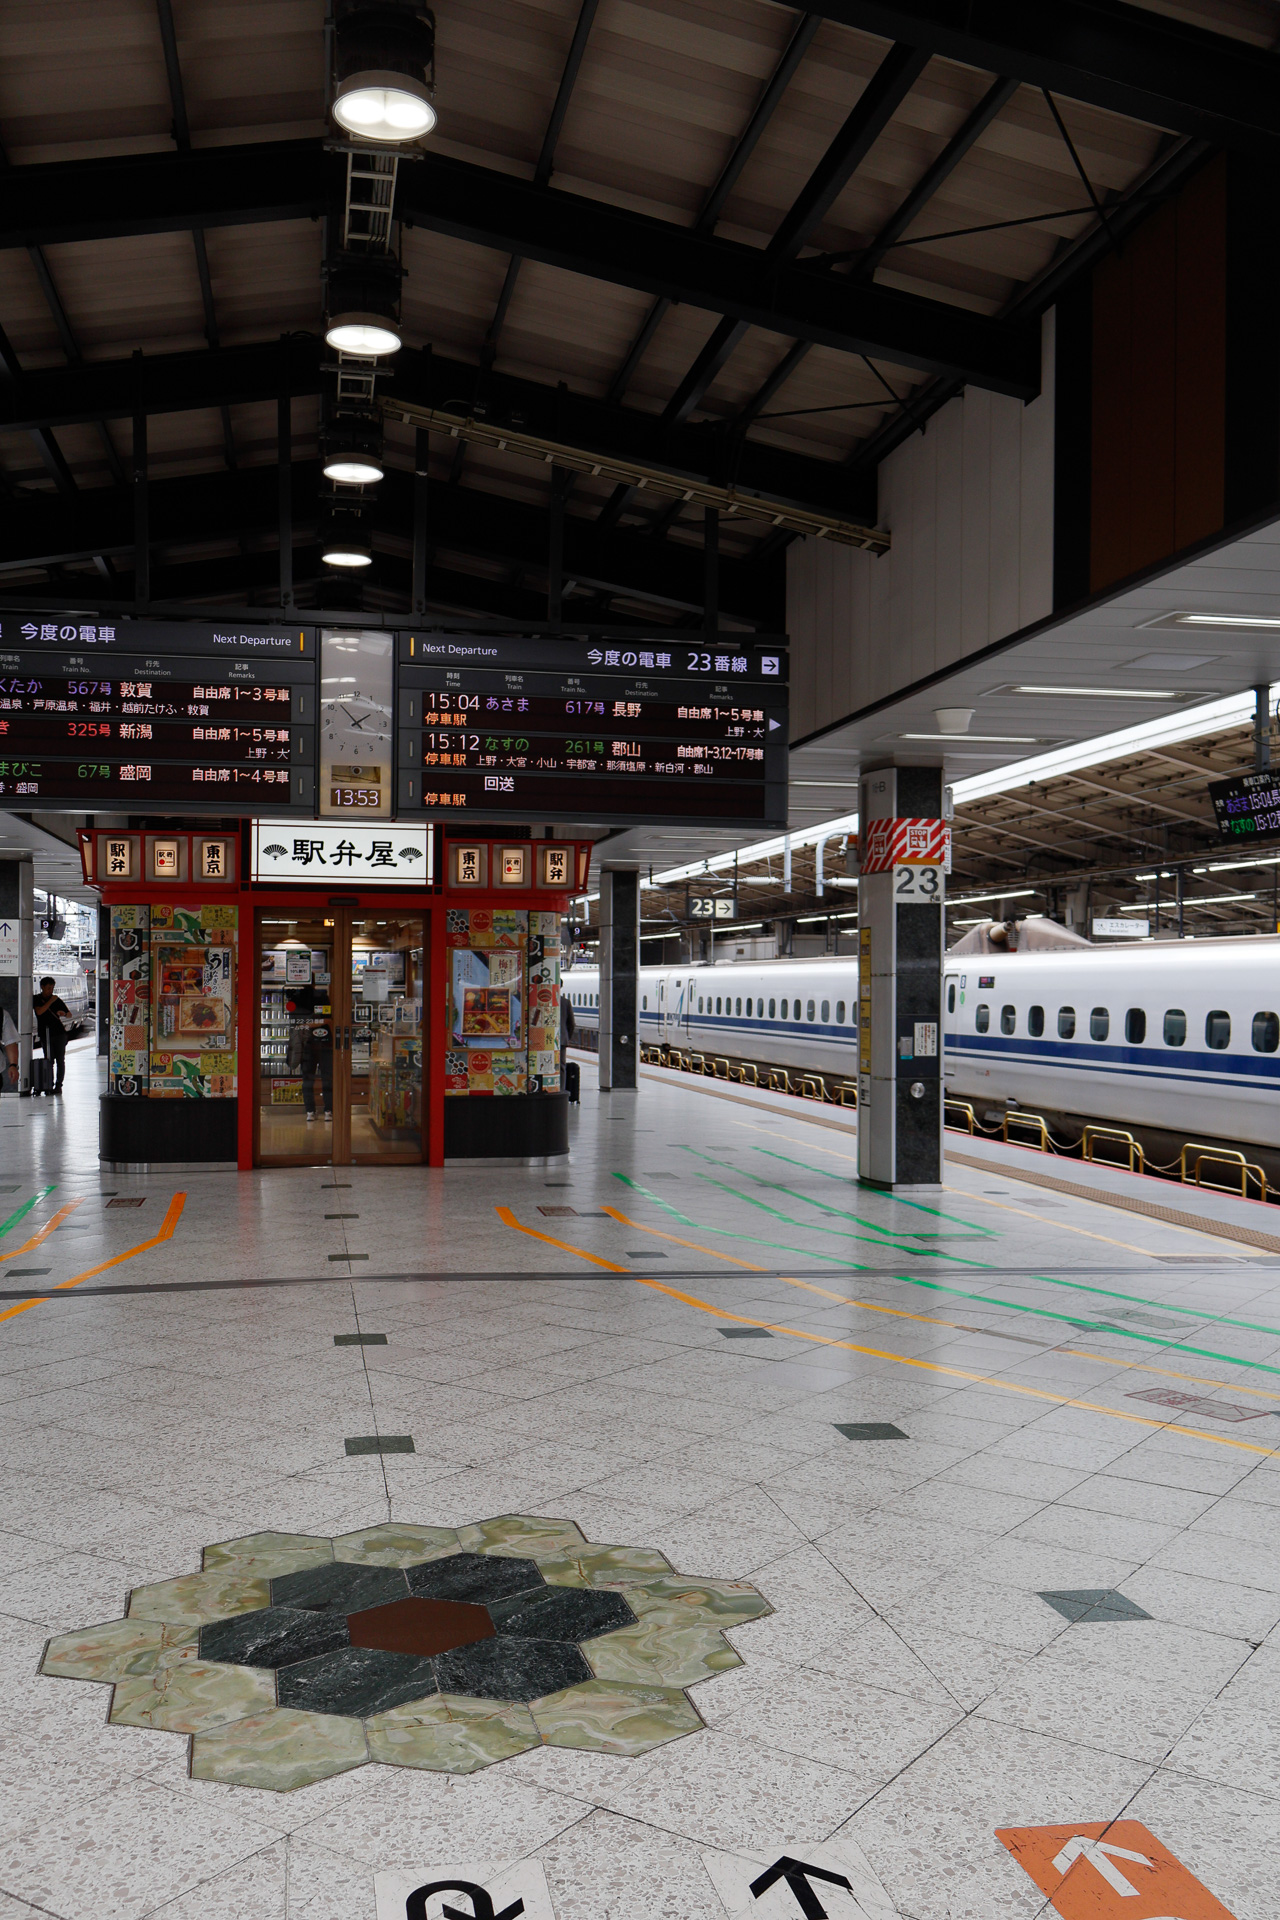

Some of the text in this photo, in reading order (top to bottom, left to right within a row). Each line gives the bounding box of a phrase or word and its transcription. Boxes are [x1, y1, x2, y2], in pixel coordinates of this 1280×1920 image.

[20, 623, 116, 644] 今度の電車
[213, 634, 292, 647] Next Departure
[422, 643, 498, 656] Next Departure
[587, 648, 748, 673] 今度の電車 23番線
[68, 682, 112, 696] 567号
[120, 682, 152, 699] 敦賀
[429, 693, 480, 710] 15:04
[486, 696, 529, 711] あさま
[565, 700, 605, 715] 617号
[612, 701, 642, 718] 長野
[425, 712, 467, 726] 停車駅
[68, 722, 111, 737] 325号
[120, 723, 152, 740] 新潟
[429, 733, 480, 751] 15:12
[485, 736, 529, 752] なすの
[565, 740, 605, 754] 261号
[612, 741, 641, 757] 郡山
[424, 752, 466, 766] 停車駅
[78, 764, 111, 779] 67号
[120, 765, 152, 781] 盛岡
[484, 776, 515, 792] 回送
[334, 789, 379, 806] 13:53
[424, 792, 466, 806] 停車駅
[1226, 796, 1250, 813] あさま
[1249, 791, 1273, 810] 15:04
[1230, 818, 1255, 834] なすの
[1254, 812, 1279, 830] 15:12
[110, 843, 125, 872] 駅弁
[206, 844, 220, 874] 東京
[292, 839, 398, 868] 駅弁屋
[462, 851, 476, 879] 東京
[550, 852, 563, 880] 駅弁
[896, 867, 938, 894] 23
[692, 899, 714, 915] 23
